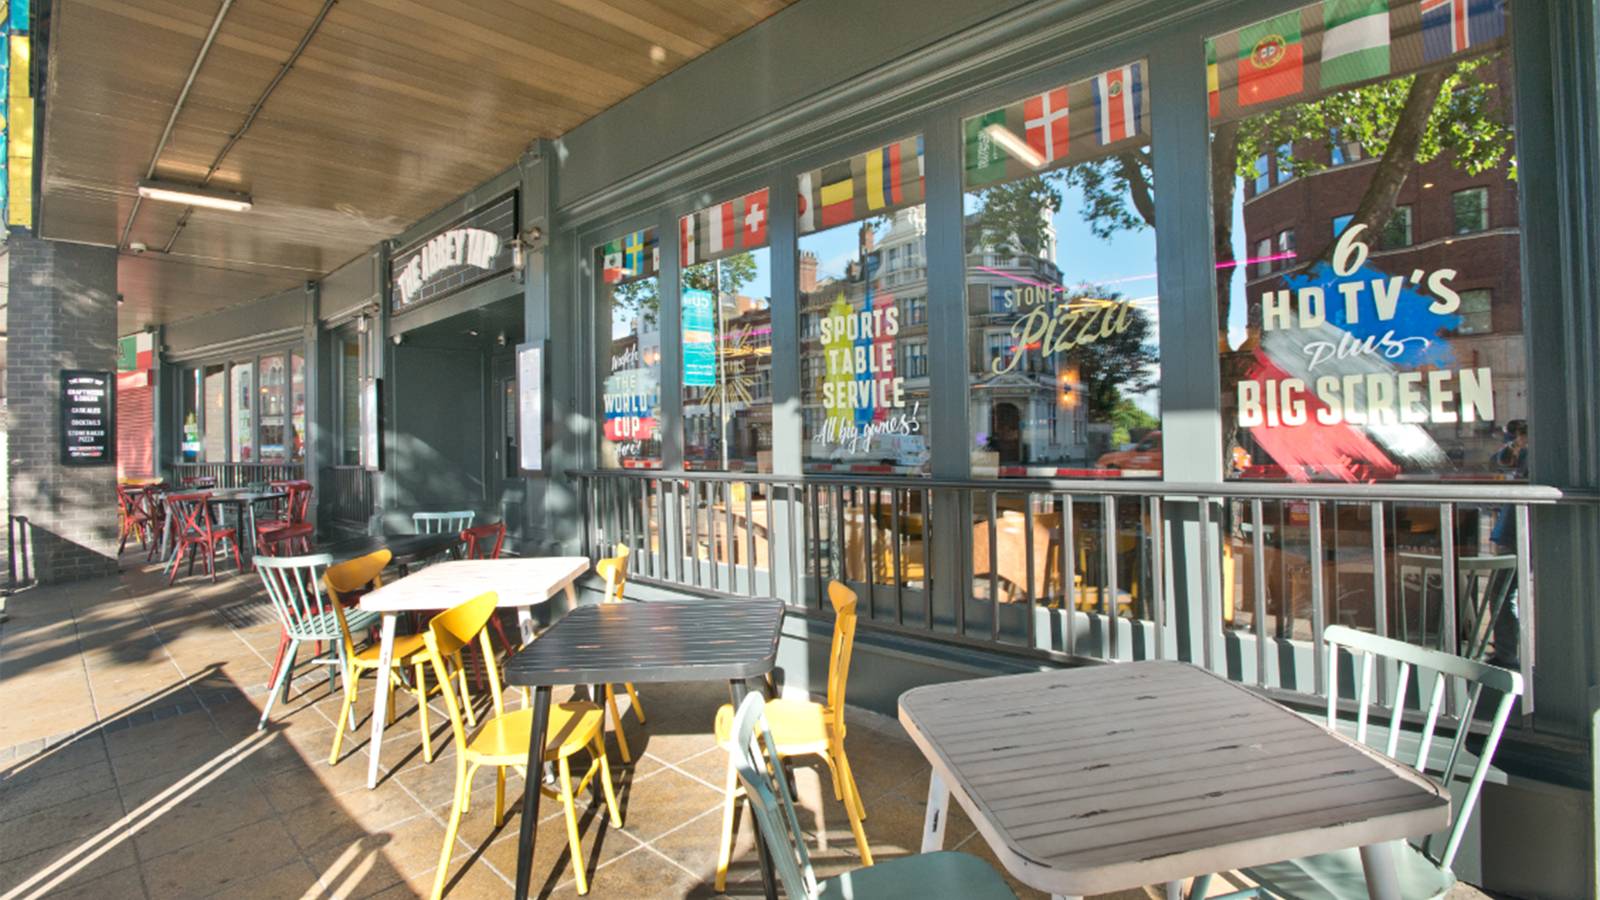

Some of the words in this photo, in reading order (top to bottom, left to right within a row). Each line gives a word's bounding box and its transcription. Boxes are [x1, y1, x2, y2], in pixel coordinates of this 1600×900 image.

[397, 253, 424, 304] THE
[421, 228, 468, 281] ABBEY
[466, 226, 500, 271] TAP
[1331, 222, 1370, 278] 6
[1261, 286, 1327, 331] HD
[1337, 267, 1462, 325] TV'S
[819, 306, 900, 345] SPORTS
[991, 303, 1133, 375] Pizza
[615, 375, 638, 389] THE
[828, 342, 894, 375] TABLE
[603, 393, 649, 413] WORLD
[822, 376, 906, 410] SERVICE
[1237, 377, 1308, 428] BIG
[1315, 366, 1496, 427] SCREEN
[613, 415, 641, 437] CUP
[813, 416, 836, 447] All
[838, 416, 861, 455] big
[862, 400, 921, 453] games!
